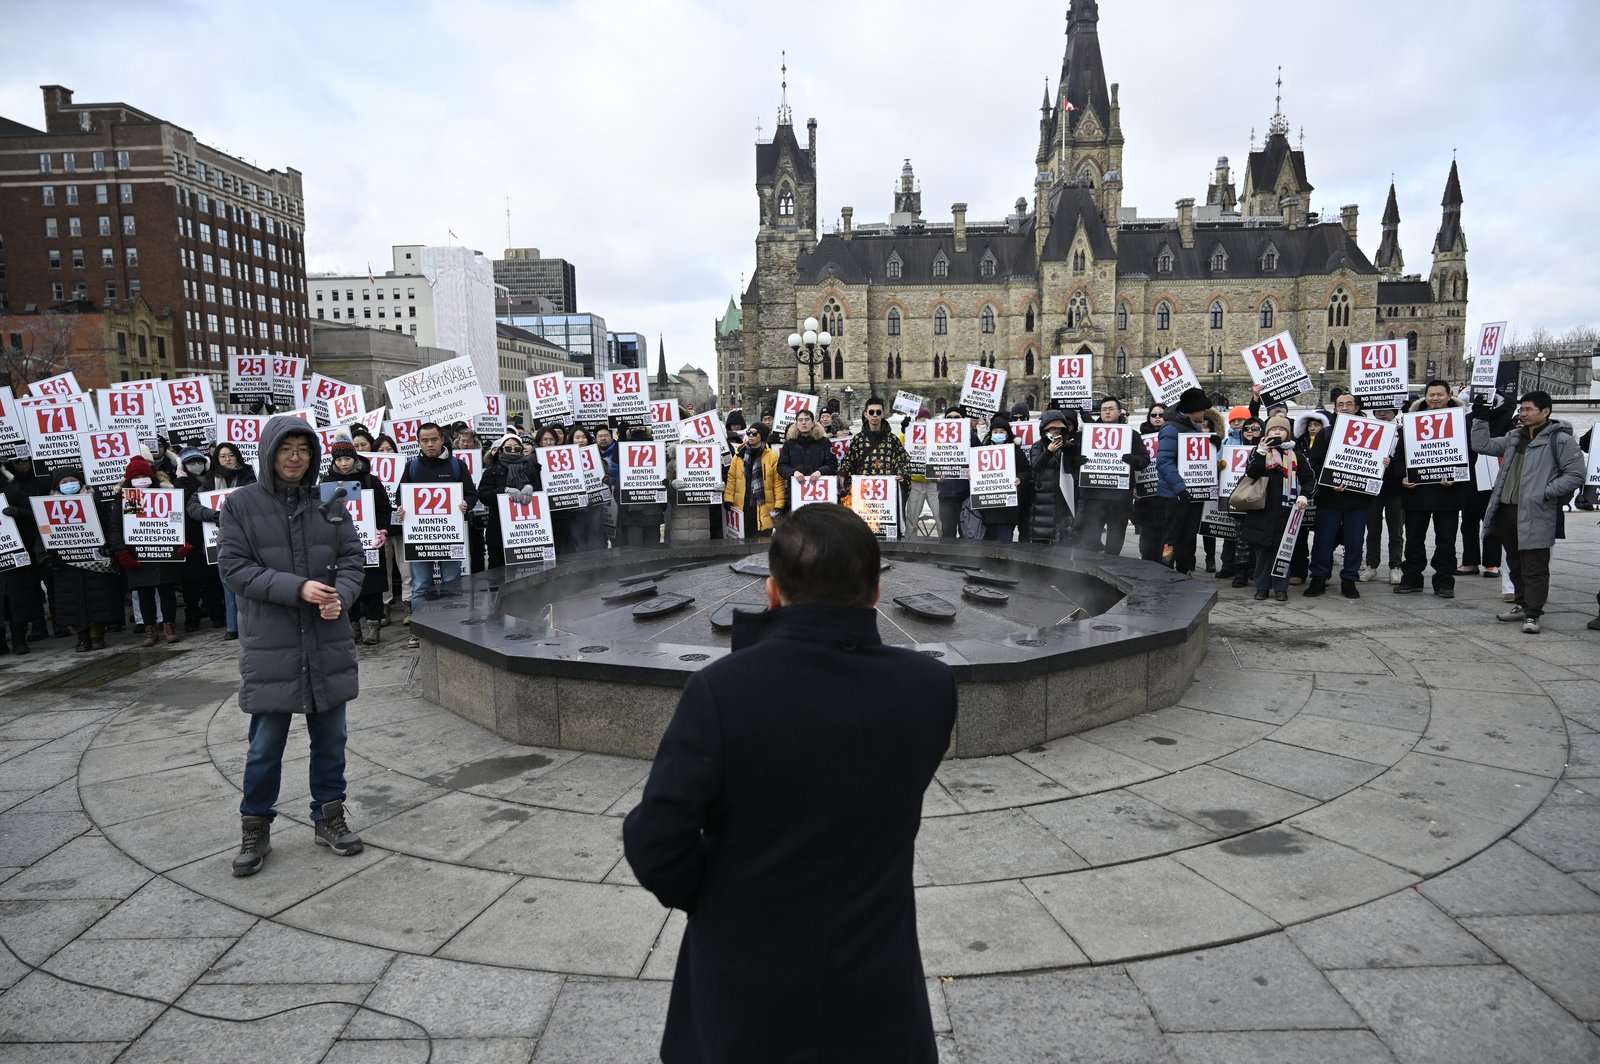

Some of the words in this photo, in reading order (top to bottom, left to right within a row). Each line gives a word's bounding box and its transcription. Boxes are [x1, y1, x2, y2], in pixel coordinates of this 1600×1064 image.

[1482, 327, 1498, 355] 33
[1256, 340, 1281, 367] 37
[1365, 345, 1393, 369] 40
[240, 359, 262, 375] 25
[274, 360, 292, 377] 31
[1062, 359, 1080, 377] 19
[1155, 360, 1178, 385] 13
[1264, 362, 1288, 375] MONTHS
[399, 373, 425, 391] ASSEZ
[402, 366, 476, 400] INTERMINABLE
[537, 377, 556, 398] 63
[616, 373, 637, 393] 34
[974, 370, 995, 392] 43
[1162, 379, 1184, 392] MONTHS
[1181, 381, 1192, 390] FOR
[1261, 371, 1285, 384] WAITING
[1273, 370, 1302, 387] RESPONSE
[42, 380, 69, 396] 36
[173, 382, 199, 405] 53
[320, 380, 341, 399] 31
[582, 384, 602, 402] 38
[113, 394, 140, 415] 15
[336, 395, 356, 418] 34
[399, 403, 412, 411] Nos
[413, 398, 426, 407] vies
[428, 392, 442, 401] sont
[786, 396, 807, 414] 27
[41, 407, 72, 433] 71
[183, 418, 214, 426] RESPONSE
[651, 403, 668, 422] 37
[231, 419, 257, 441] 68
[397, 423, 419, 443] 34
[937, 423, 959, 443] 33
[1348, 421, 1380, 449] 37
[1420, 413, 1448, 440] 37
[96, 434, 126, 458] 53
[1094, 428, 1119, 449] 30
[1190, 437, 1207, 460] 31
[1420, 441, 1450, 449] MONTHS
[549, 449, 572, 471] 33
[632, 446, 653, 466] 72
[688, 448, 709, 467] 23
[981, 450, 1004, 471] 90
[1335, 453, 1363, 464] WAITING
[1344, 448, 1372, 458] MONTHS
[1414, 450, 1443, 458] WAITING
[1426, 455, 1463, 464] RESPONSE
[93, 467, 121, 475] WAITING
[370, 458, 392, 482] 40
[1329, 460, 1344, 468] IRCC
[1345, 462, 1380, 475] RESPONSE
[558, 484, 583, 492] RESPONSE
[803, 480, 826, 501] 25
[863, 479, 885, 500] 33
[143, 493, 168, 518] 40
[418, 488, 447, 514] 22
[51, 500, 82, 524] 42
[514, 503, 537, 520] 11
[727, 510, 738, 531] 11
[64, 538, 100, 546] RESPONSE
[510, 530, 533, 538] WAITING
